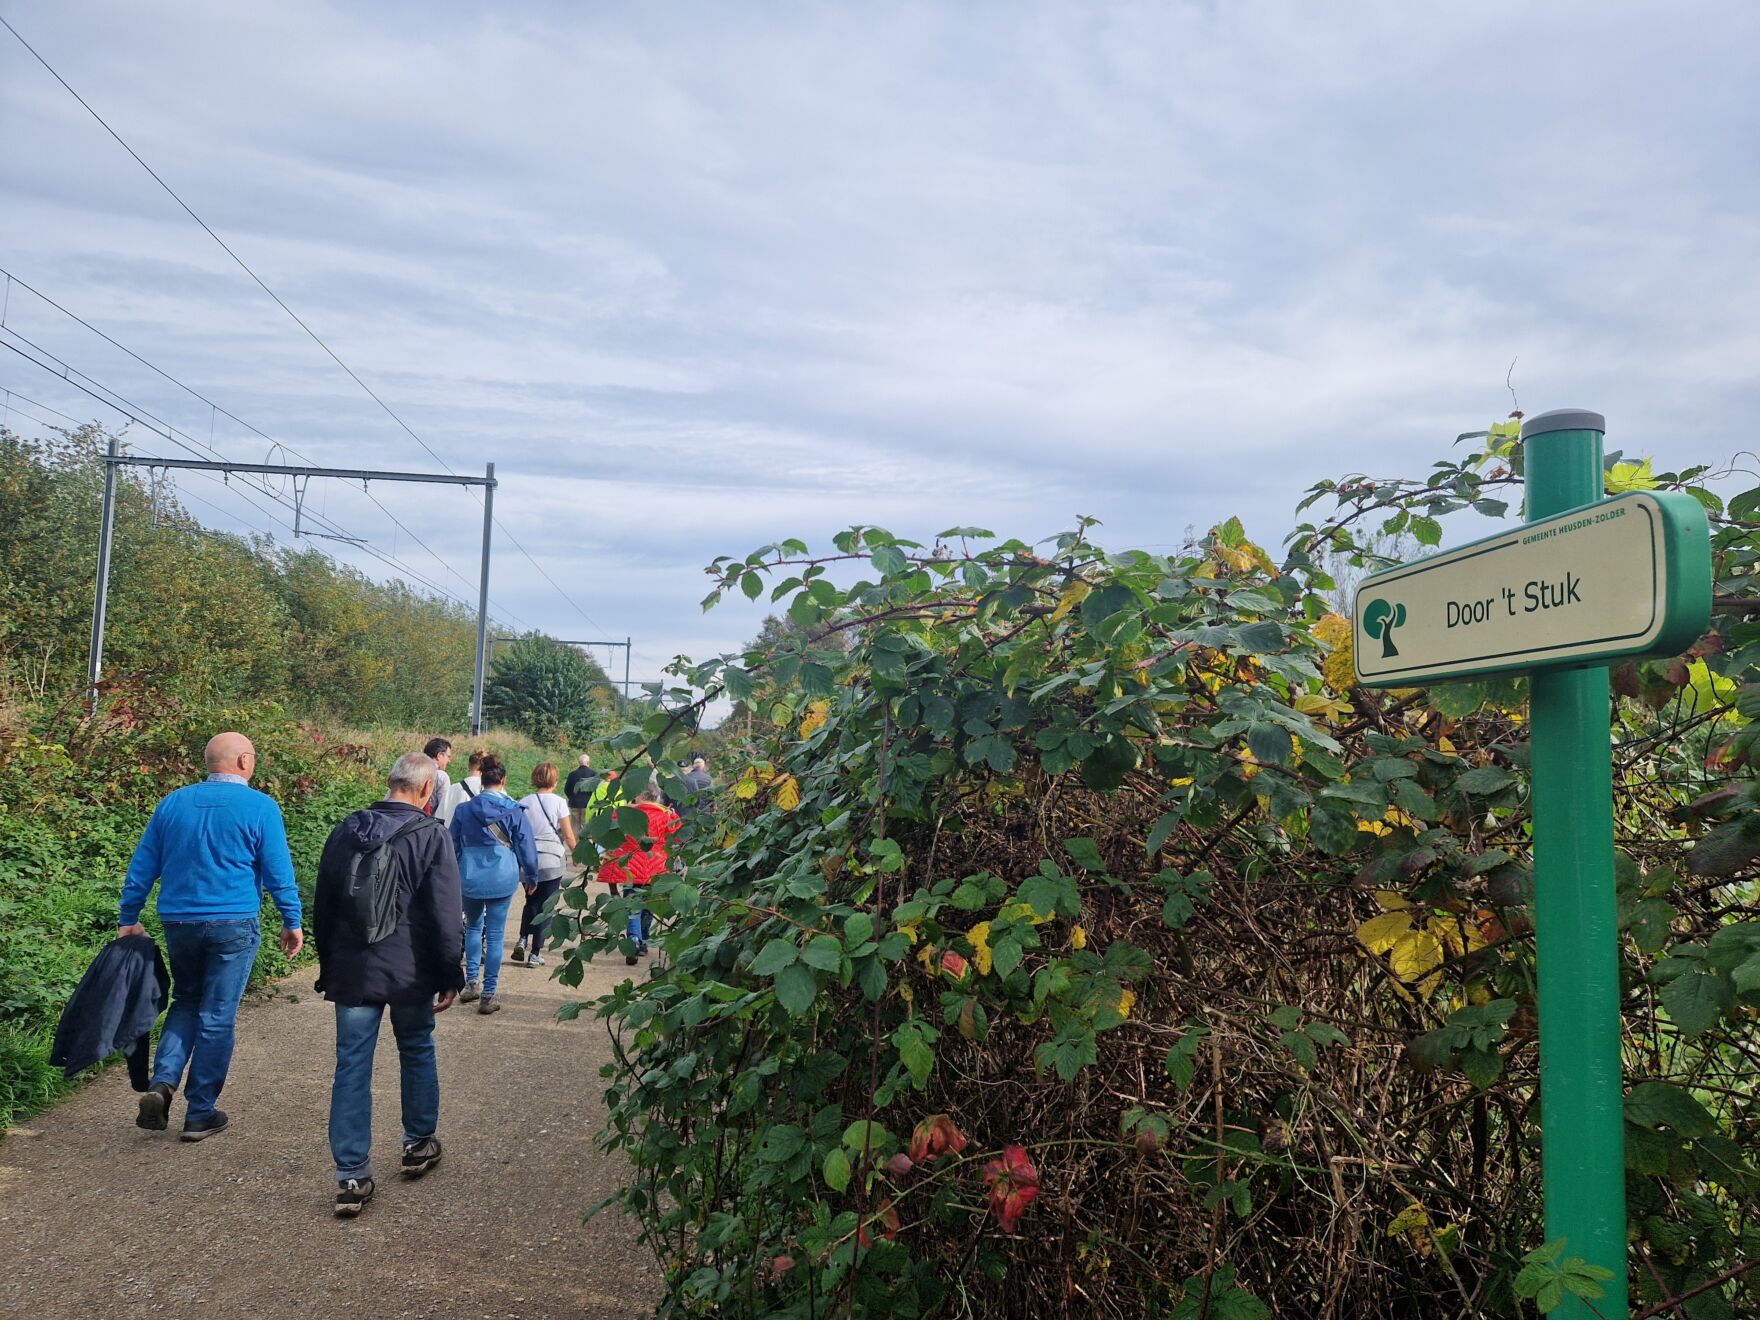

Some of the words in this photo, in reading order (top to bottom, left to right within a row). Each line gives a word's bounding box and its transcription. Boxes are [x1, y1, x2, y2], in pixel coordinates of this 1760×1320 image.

[1522, 528, 1557, 545] GEMEENTE
[1558, 507, 1626, 534] HEUSDEN-ZOLDER
[1447, 597, 1494, 628] Door
[1502, 587, 1516, 616] 't
[1524, 571, 1581, 612] Stuk
